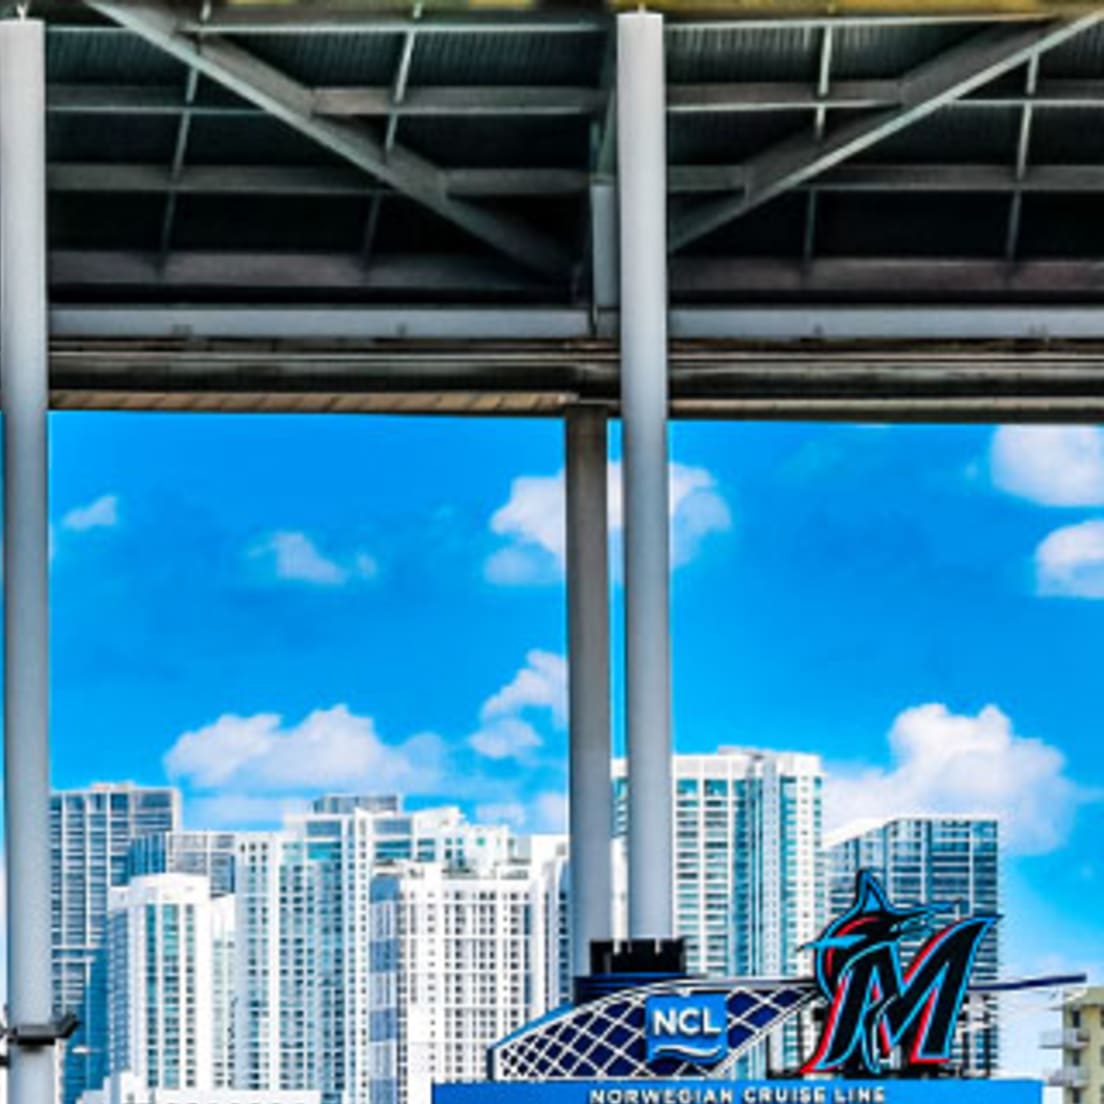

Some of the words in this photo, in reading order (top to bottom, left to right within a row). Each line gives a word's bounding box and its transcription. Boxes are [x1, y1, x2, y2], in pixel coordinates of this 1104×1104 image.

[653, 1008, 721, 1036] NCL
[590, 1088, 733, 1104] NORWEGIAN
[743, 1088, 825, 1104] CRUISE
[834, 1087, 886, 1104] LINE
